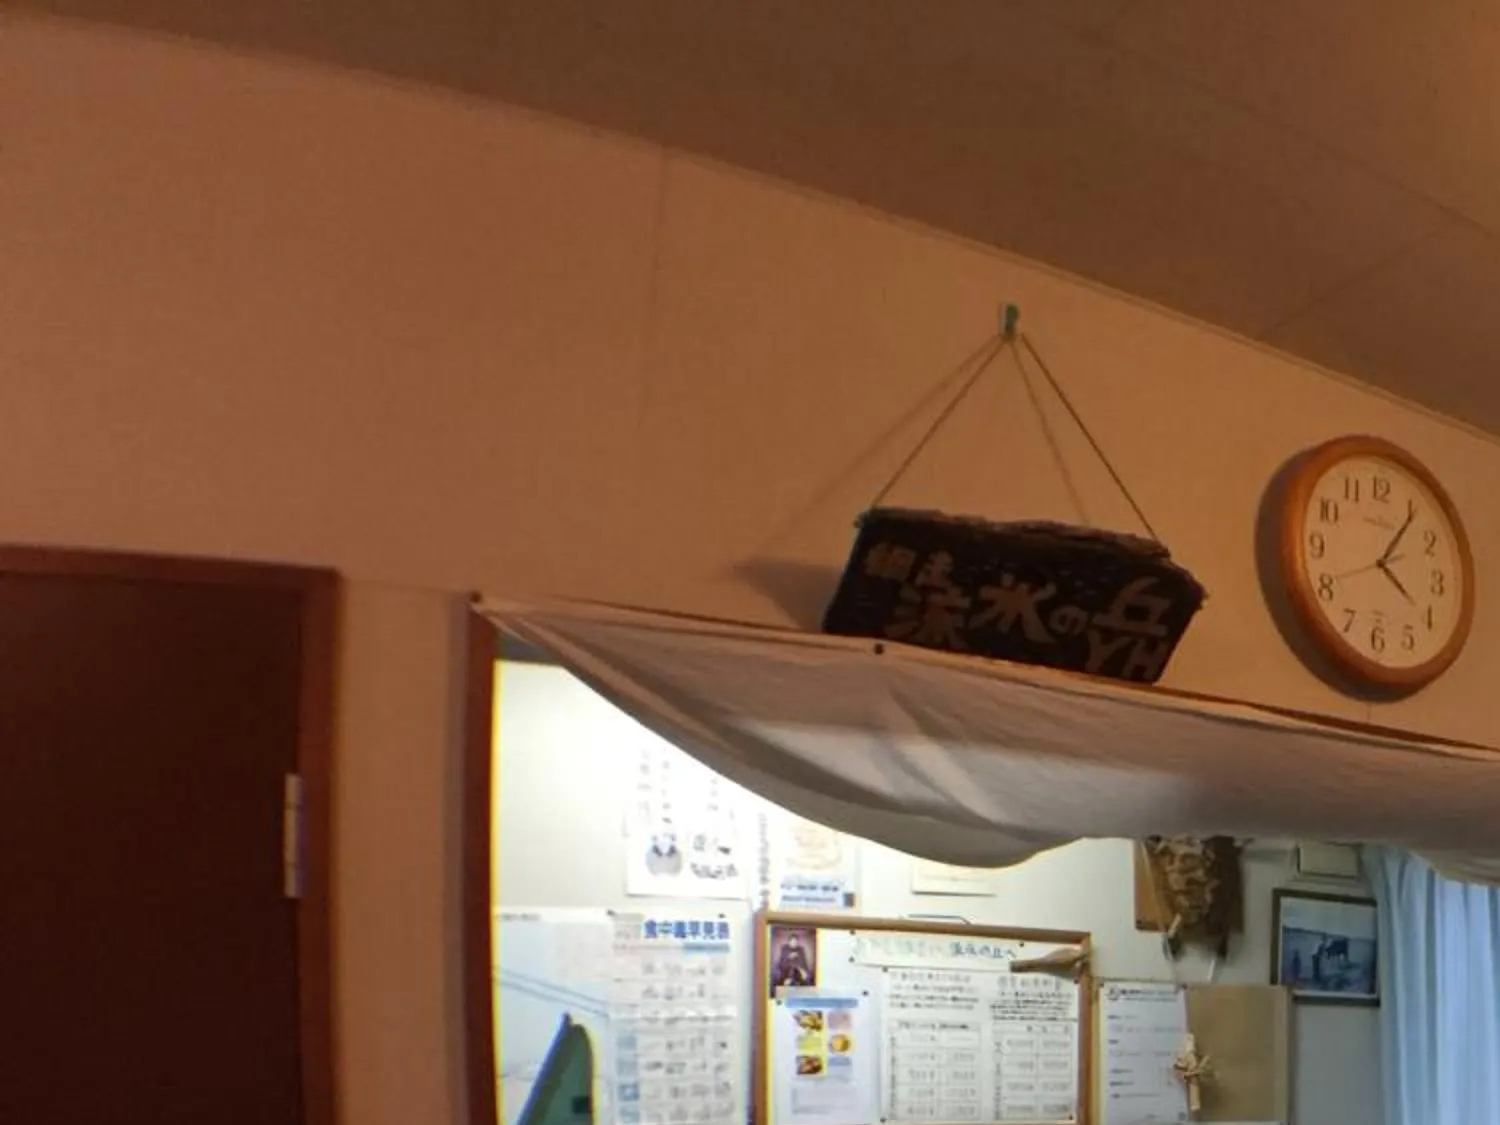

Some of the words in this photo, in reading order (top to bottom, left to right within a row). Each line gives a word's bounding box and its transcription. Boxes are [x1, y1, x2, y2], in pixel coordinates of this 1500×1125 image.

[1343, 476, 1360, 504] 11
[1373, 474, 1391, 504] 12
[1320, 496, 1339, 523] 10
[1309, 532, 1326, 560] 9
[1423, 529, 1437, 557] 2
[1318, 572, 1334, 602] 8
[1430, 568, 1446, 597] 3
[1343, 607, 1357, 634] 7
[1370, 625, 1386, 654] 6
[1400, 623, 1415, 652] 5
